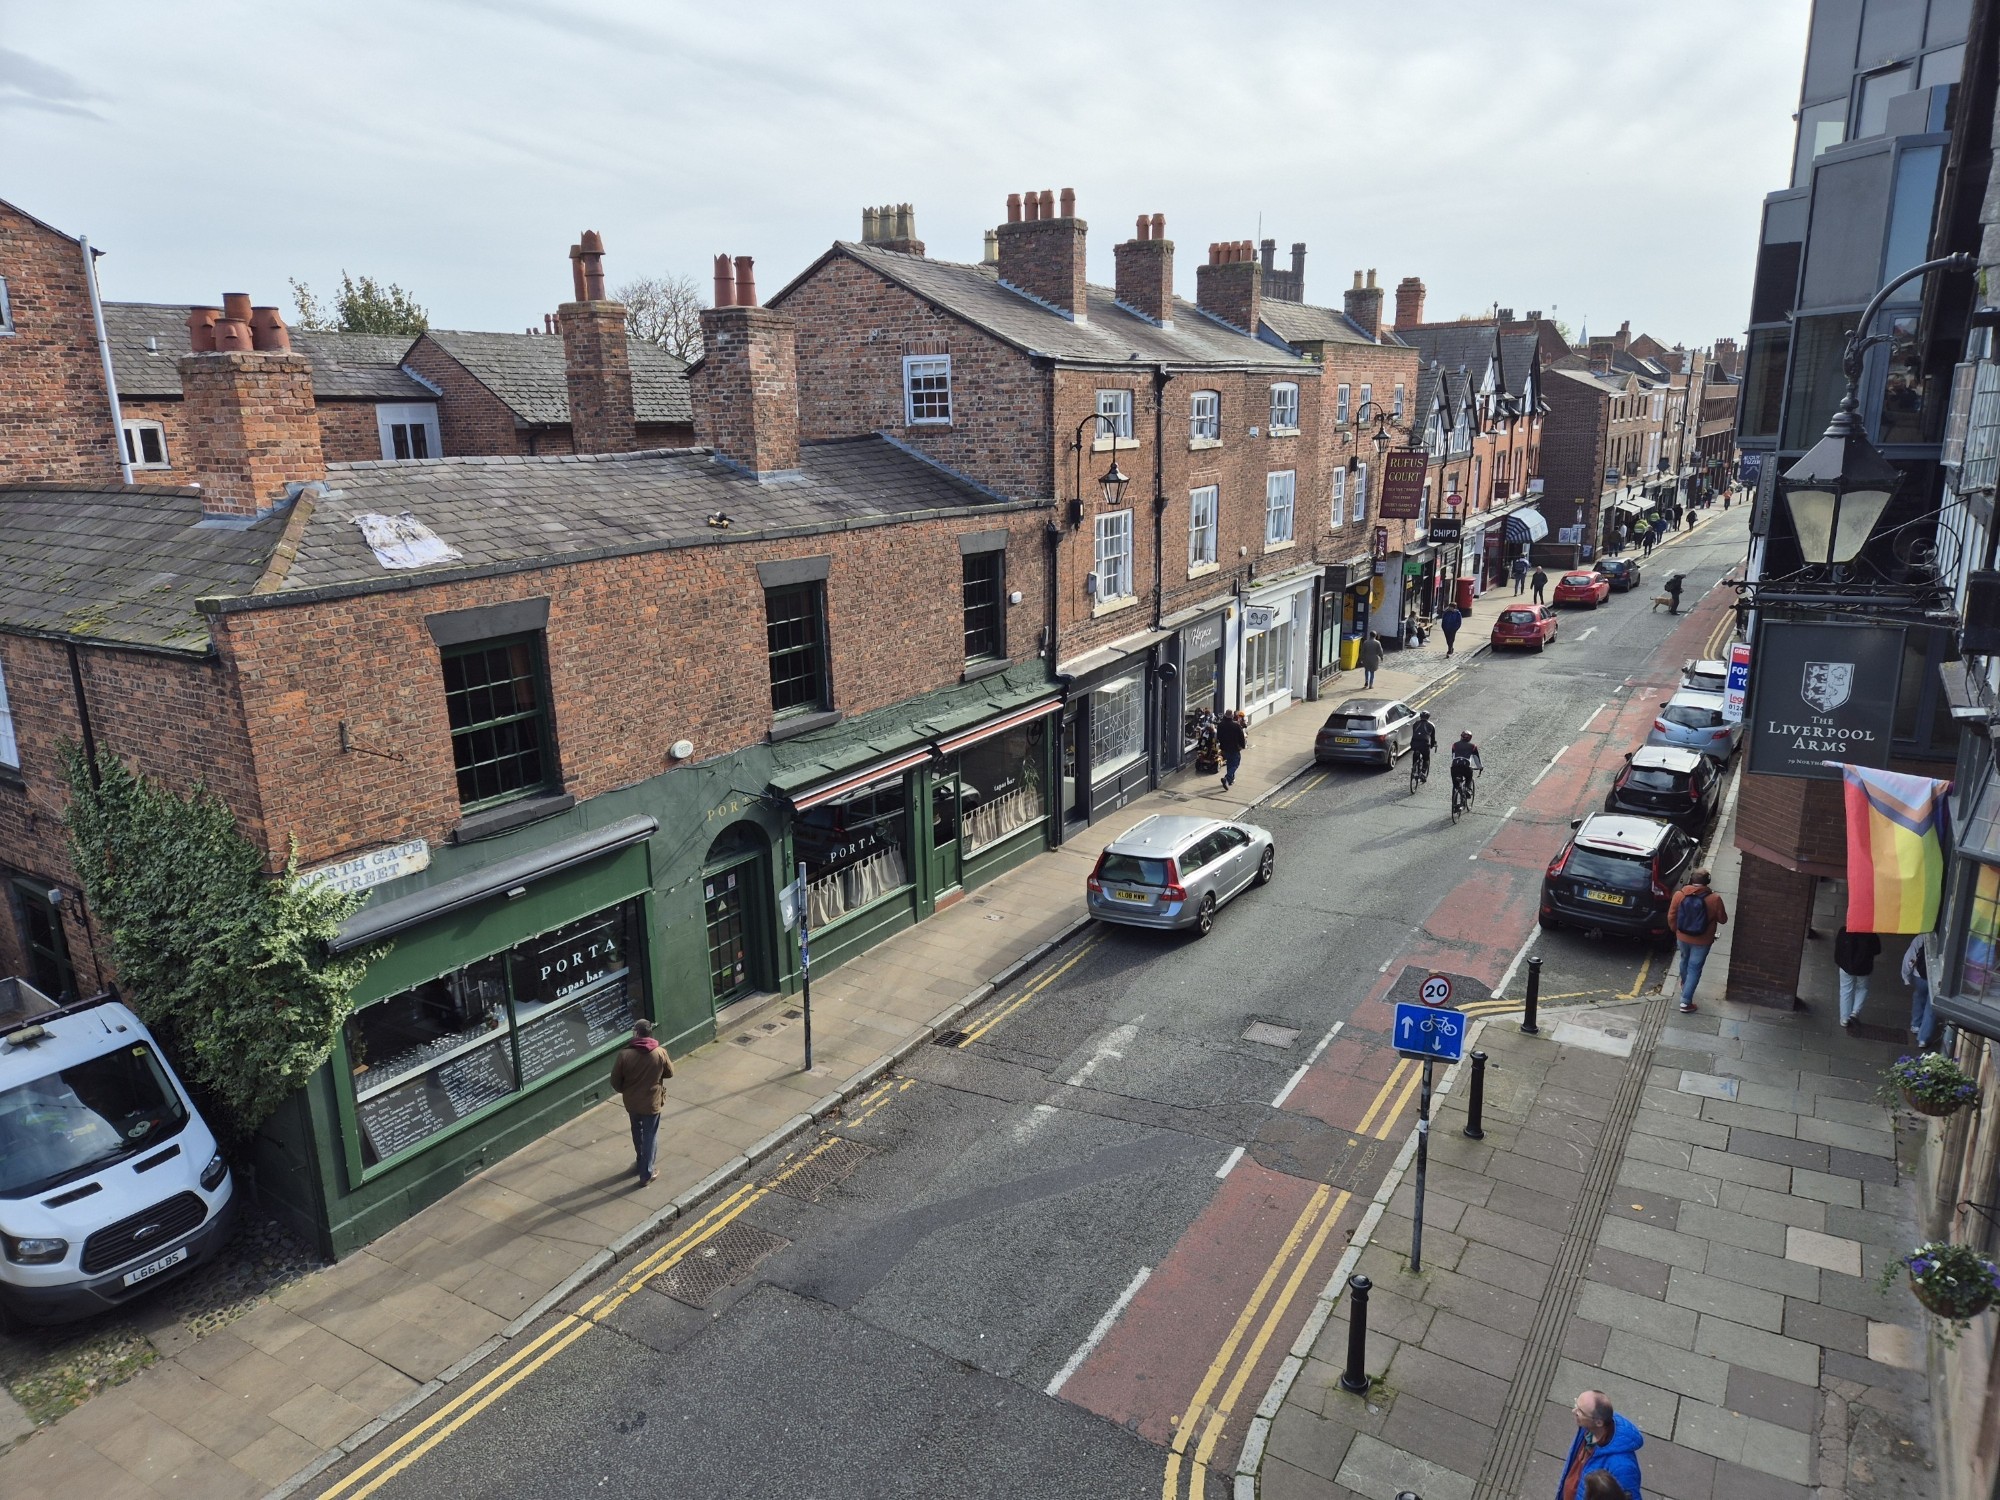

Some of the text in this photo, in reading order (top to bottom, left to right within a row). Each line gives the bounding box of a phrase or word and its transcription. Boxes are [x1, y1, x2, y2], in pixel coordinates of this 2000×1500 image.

[1390, 458, 1424, 468] RUFUS
[1388, 471, 1421, 482] COURT
[1433, 529, 1458, 538] CHIP'D
[1811, 716, 1834, 725] THE
[1768, 721, 1875, 741] LIVERPOOL
[1792, 736, 1847, 753] ARMS
[707, 796, 749, 821] PORT
[830, 835, 876, 864] PORTA
[300, 840, 423, 888] NORTH GATE
[540, 938, 616, 981] PORTA
[555, 979, 585, 997] tapas
[586, 970, 604, 983] bar
[1424, 983, 1448, 998] 20
